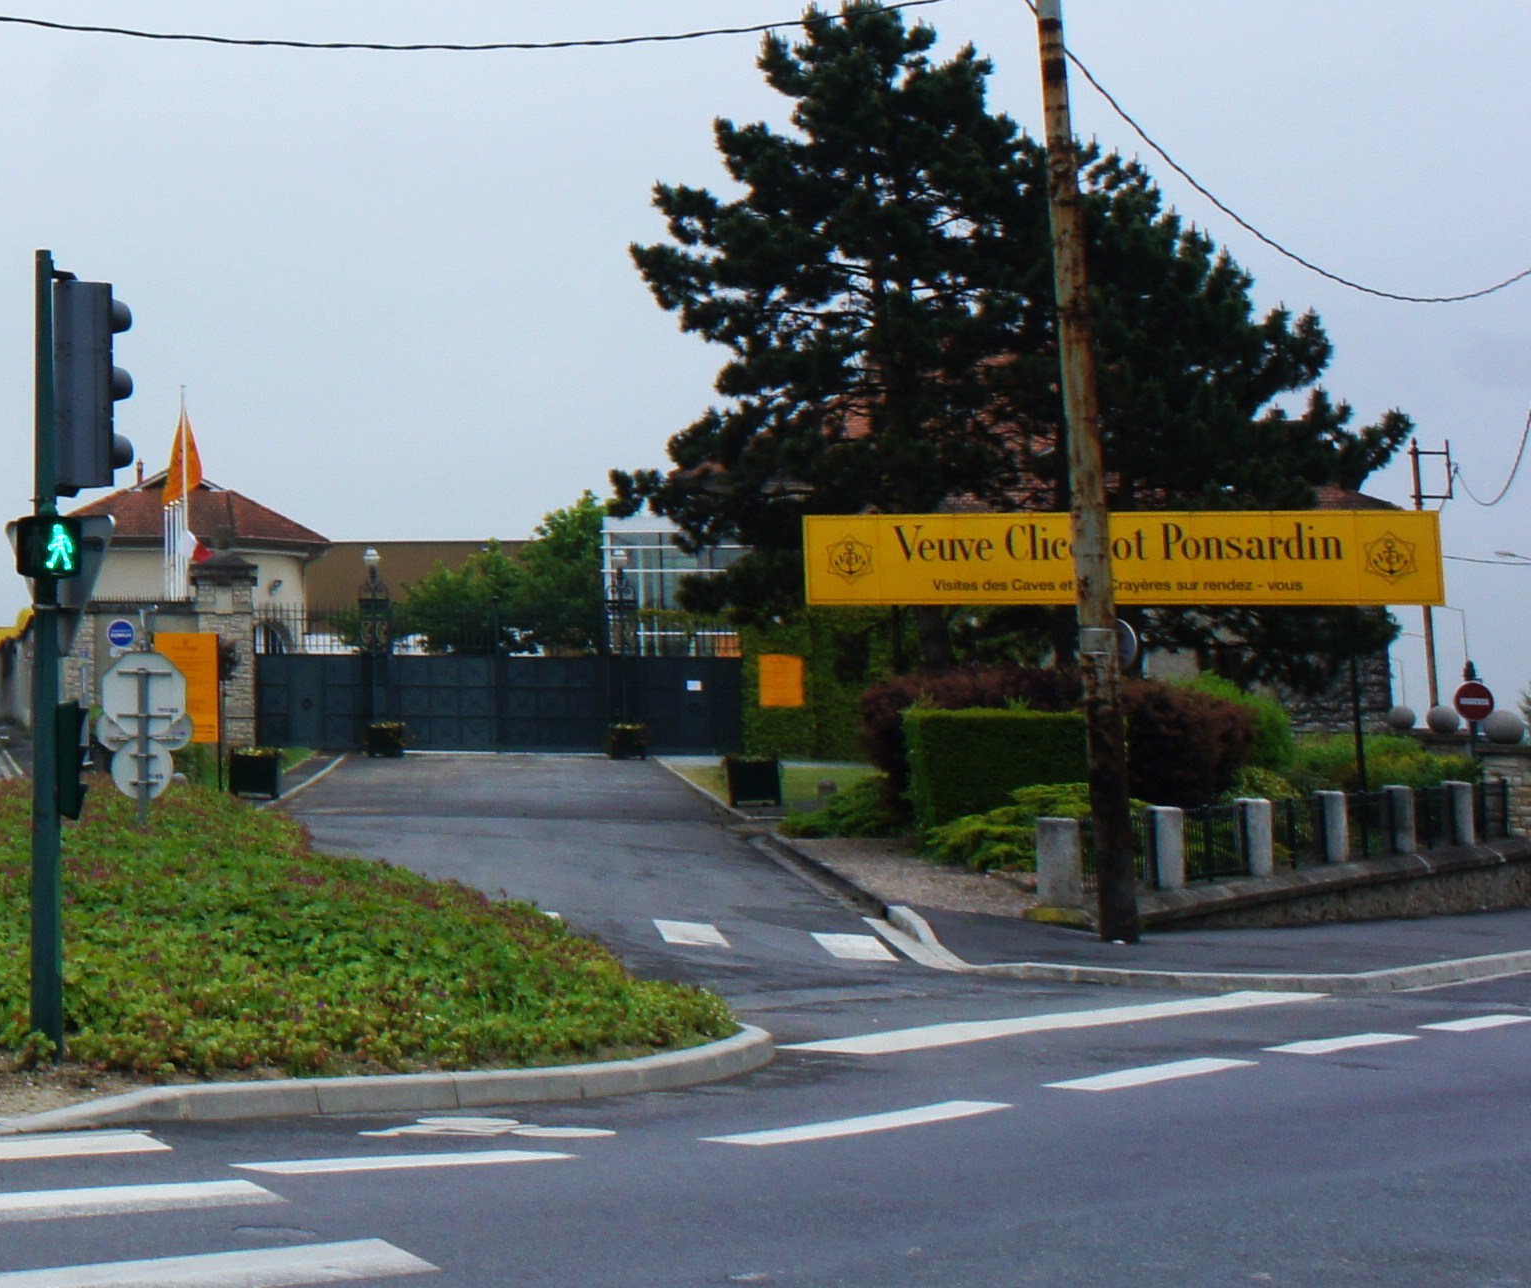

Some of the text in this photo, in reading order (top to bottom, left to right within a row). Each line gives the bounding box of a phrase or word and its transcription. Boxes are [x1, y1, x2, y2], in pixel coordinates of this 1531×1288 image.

[893, 521, 1344, 562] Veuve Clicot Ponsardin
[933, 578, 1073, 591] Visites des Caves et
[1176, 580, 1199, 591] sur
[1203, 578, 1253, 591] rendez
[1267, 580, 1304, 591] vous
